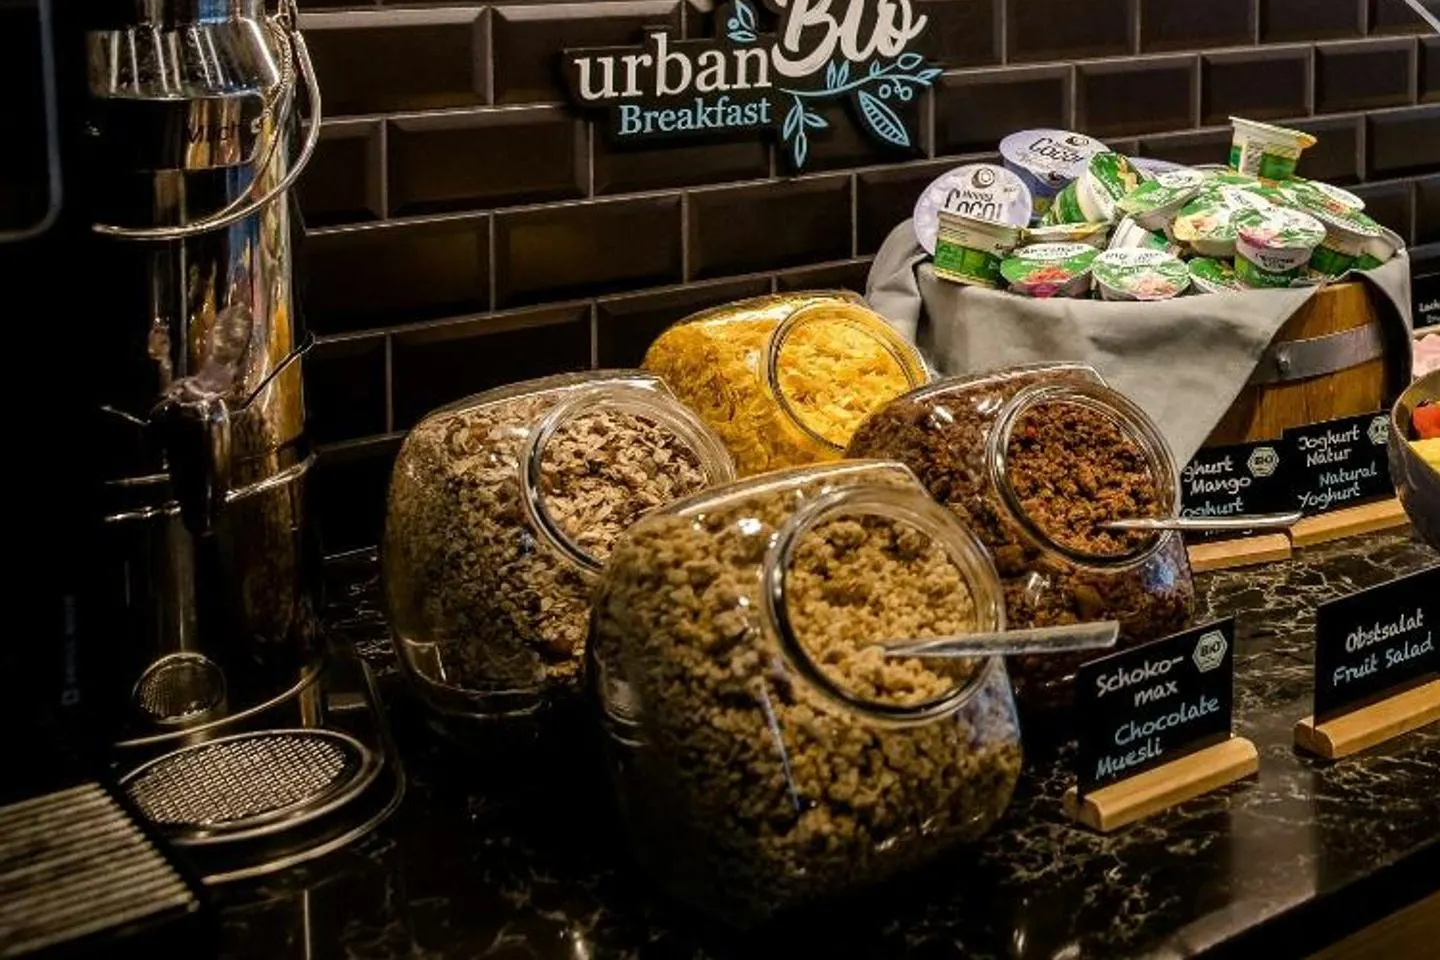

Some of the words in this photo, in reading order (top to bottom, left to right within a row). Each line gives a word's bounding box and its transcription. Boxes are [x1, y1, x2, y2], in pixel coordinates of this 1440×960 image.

[572, 31, 773, 103] urban
[617, 96, 772, 136] Breakfast
[1182, 454, 1234, 484] ghurt
[1306, 447, 1353, 468] Natur
[1318, 459, 1378, 488] Natural
[1189, 476, 1252, 497] Mango
[1297, 481, 1361, 510] Yoghurt
[1181, 496, 1245, 519] oghurt
[1344, 607, 1425, 656] Obstsalat
[1095, 653, 1185, 699] Schoko-
[1333, 656, 1380, 688] Fruit
[1385, 630, 1435, 671] Salad
[1133, 682, 1180, 709] max
[1114, 695, 1221, 748] Chocolate
[1094, 736, 1164, 782] Muesli
